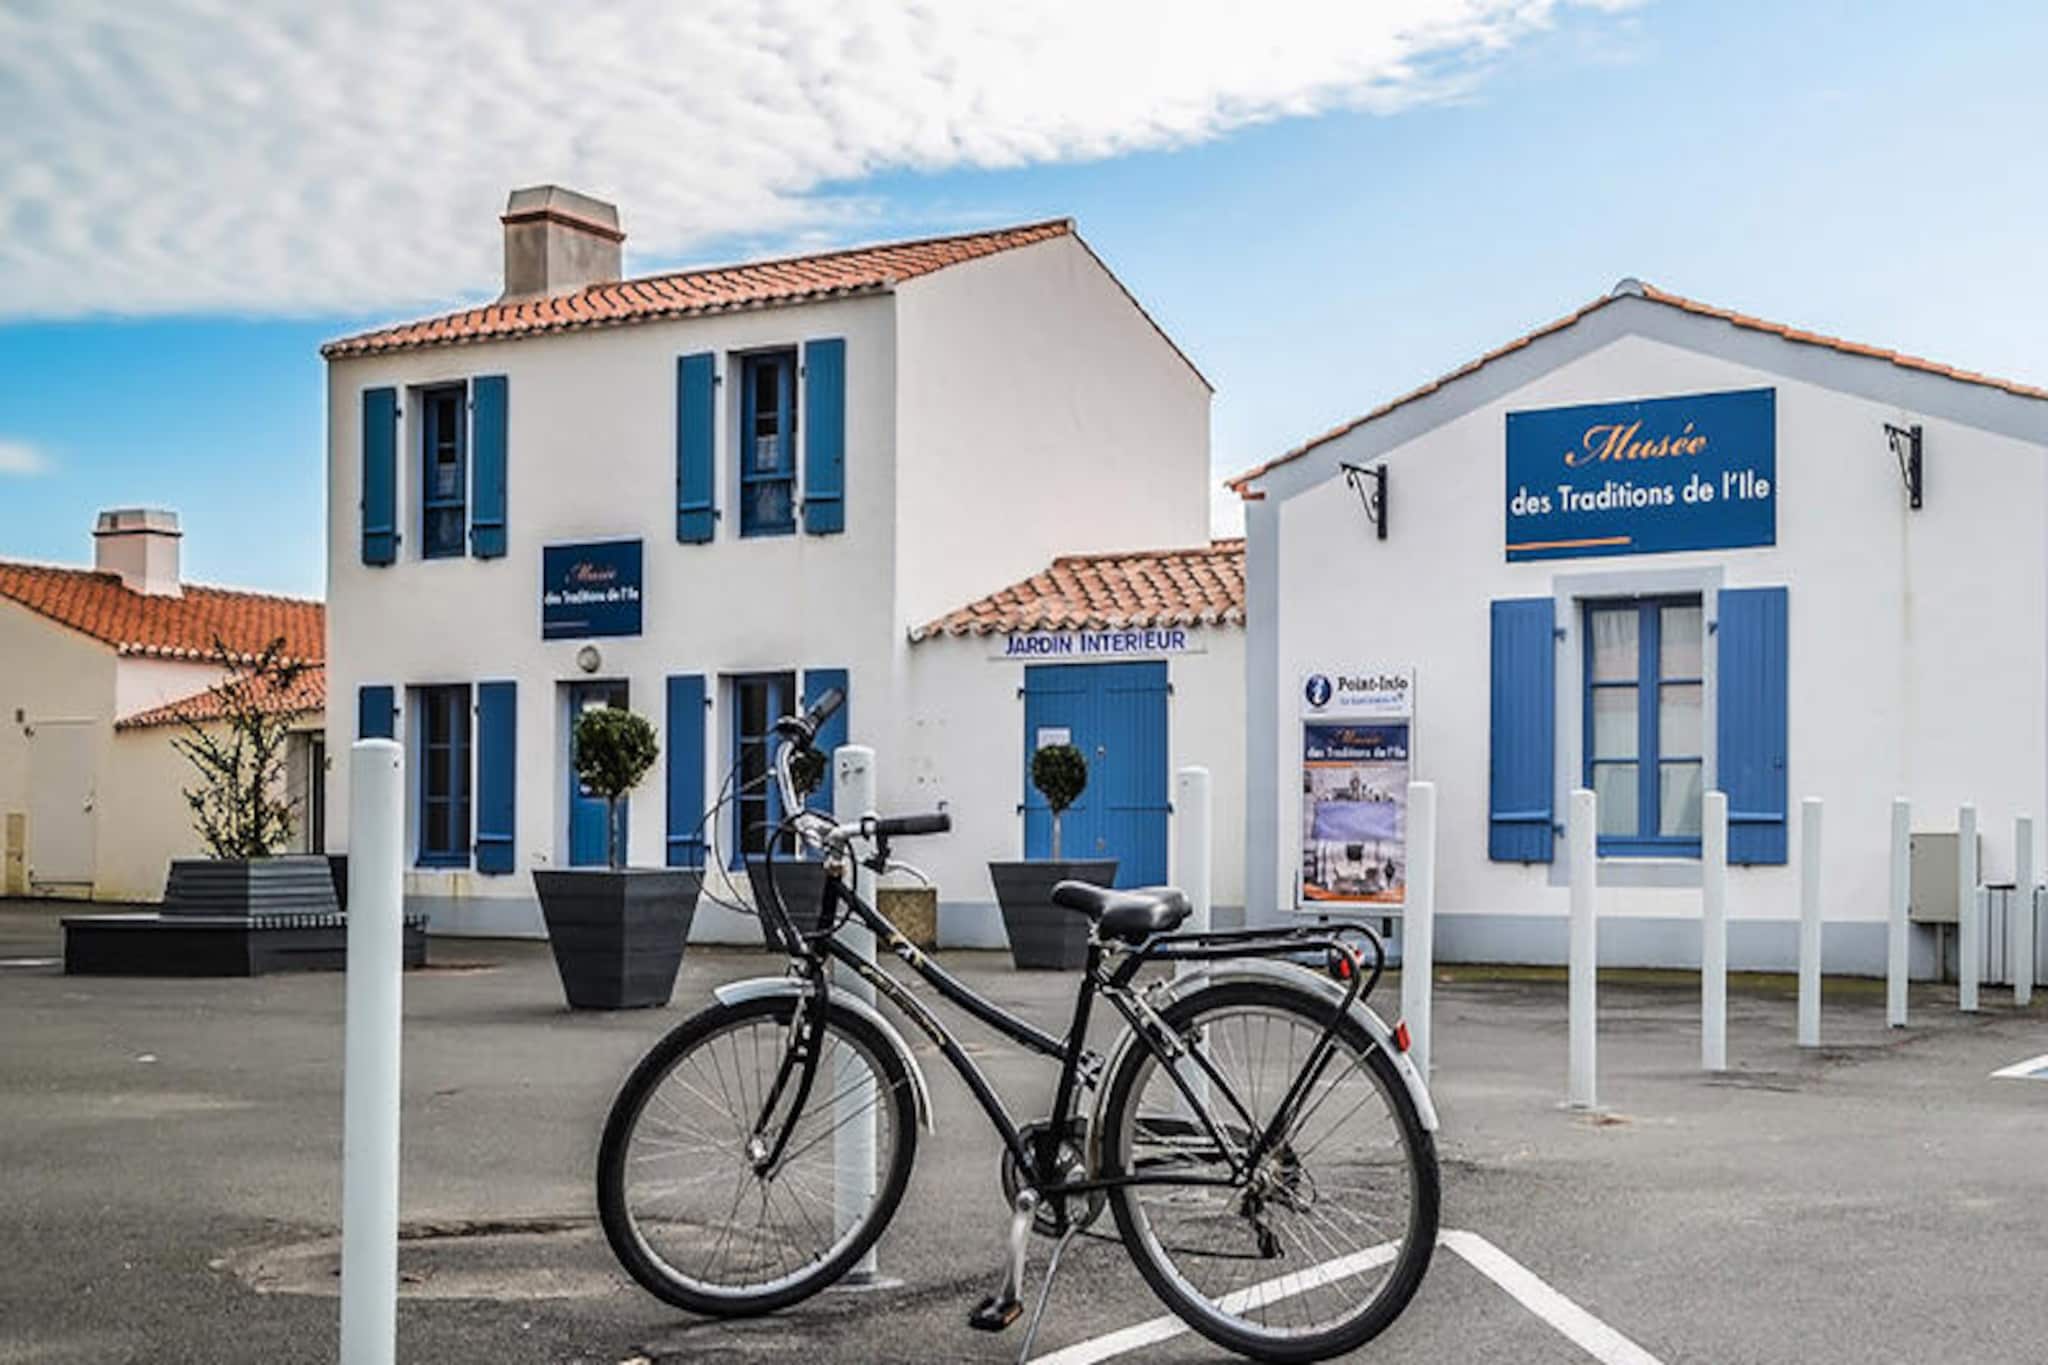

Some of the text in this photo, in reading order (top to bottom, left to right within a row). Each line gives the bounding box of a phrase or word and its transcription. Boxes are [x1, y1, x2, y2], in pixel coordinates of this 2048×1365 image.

[1564, 420, 1707, 467] Musée
[1511, 485, 1552, 516] des
[1557, 480, 1675, 512] Traditions
[1682, 474, 1715, 504] de
[1006, 631, 1185, 655] JARDIN INTERIEUR
[1337, 675, 1409, 692] Point-Info
